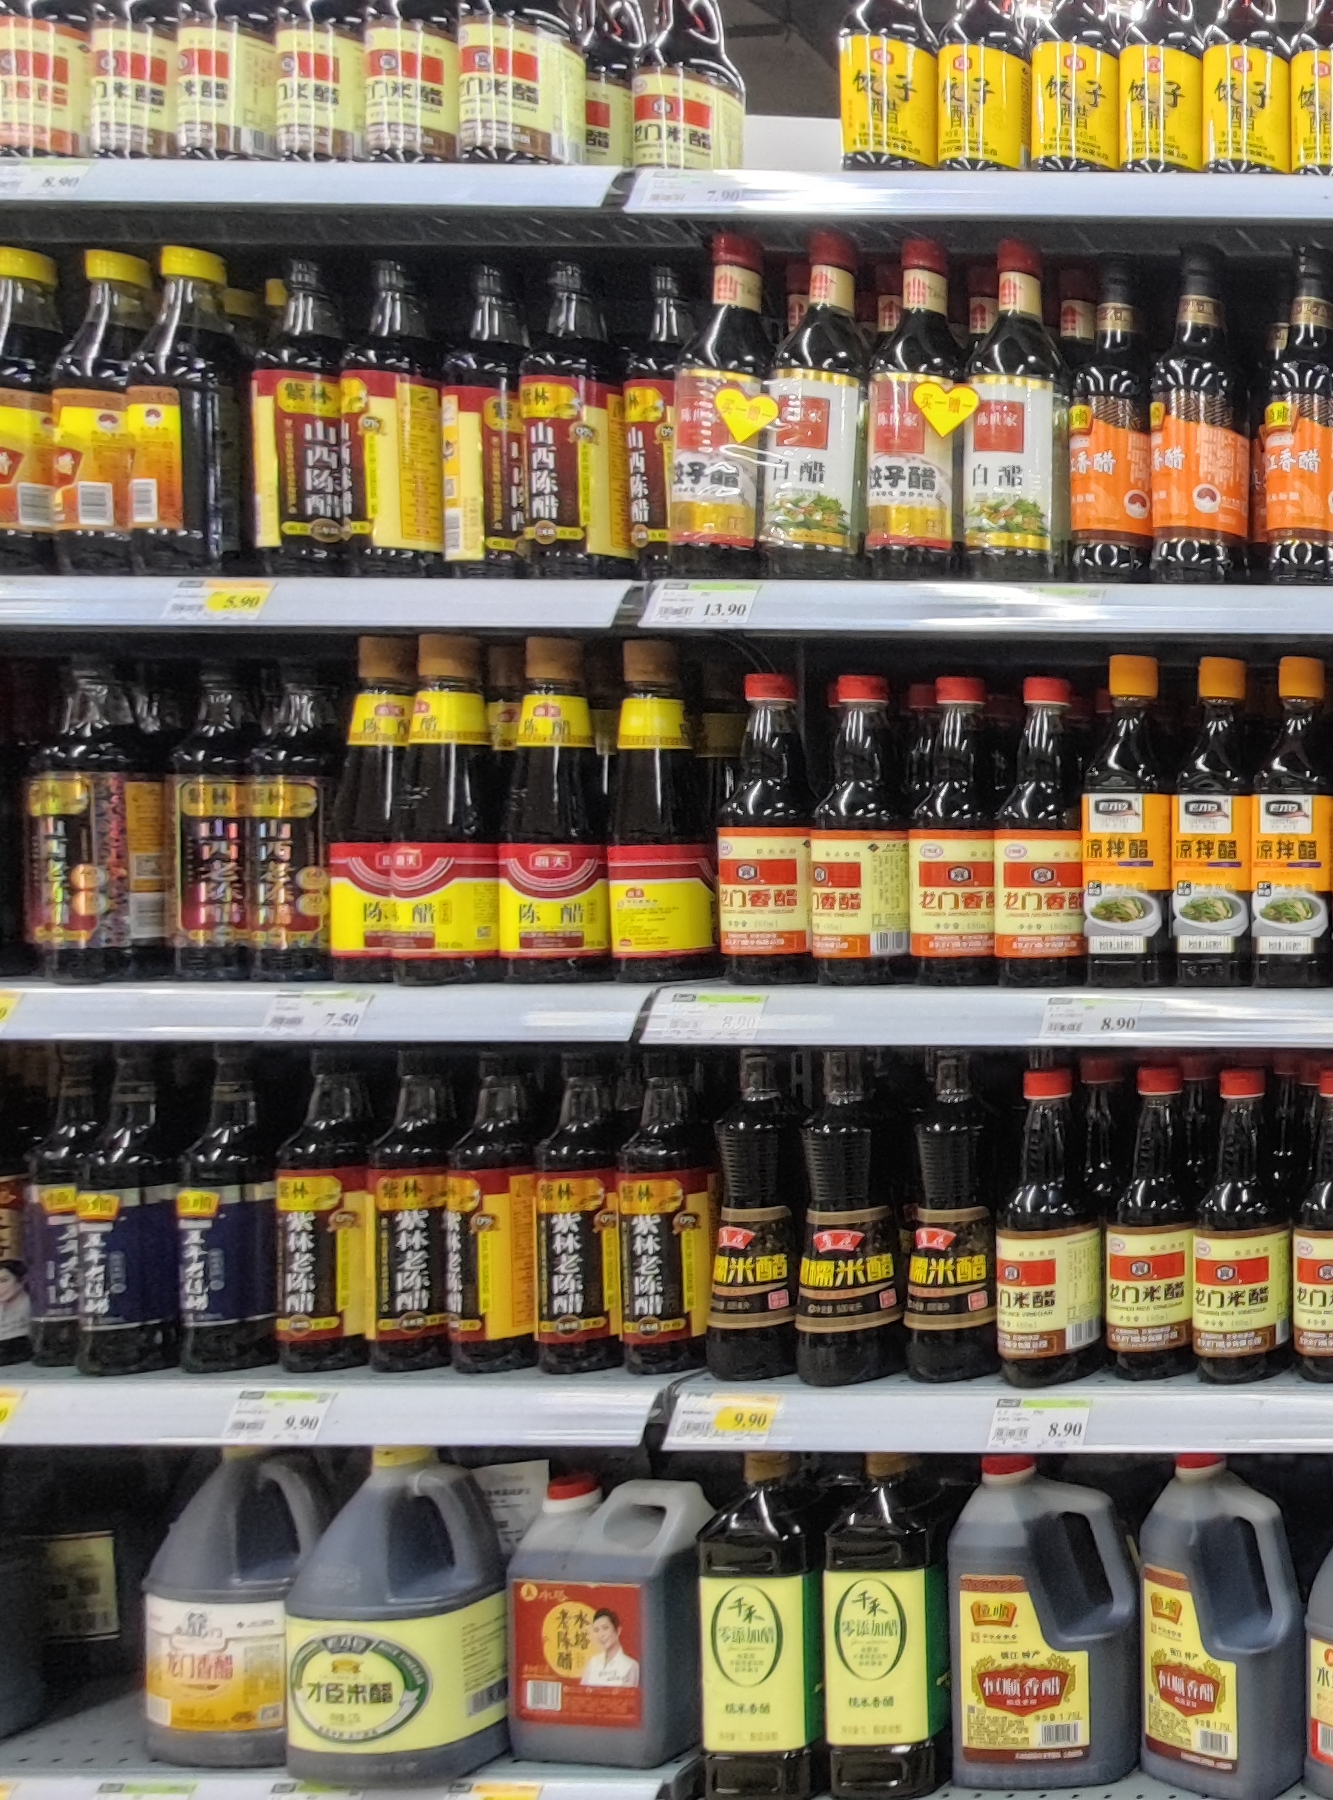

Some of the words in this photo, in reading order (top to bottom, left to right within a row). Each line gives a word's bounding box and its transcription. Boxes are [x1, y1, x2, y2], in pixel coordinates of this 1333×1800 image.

[222, 595, 260, 610] 5.90
[703, 603, 747, 618] 13.90
[324, 1013, 359, 1027] 7.50
[1100, 1017, 1136, 1031] 8.90
[287, 1212, 315, 1312] 紫林老陈醋
[396, 1210, 429, 1309] 紫林老陈醋
[552, 1213, 583, 1315] 紫林老陈醋
[632, 1213, 663, 1315] 紫林老陈醋
[283, 1416, 318, 1430] 9.90
[732, 1412, 767, 1428] 9.90
[1048, 1422, 1082, 1437] 8.90
[308, 1680, 393, 1705] 才臣米醋
